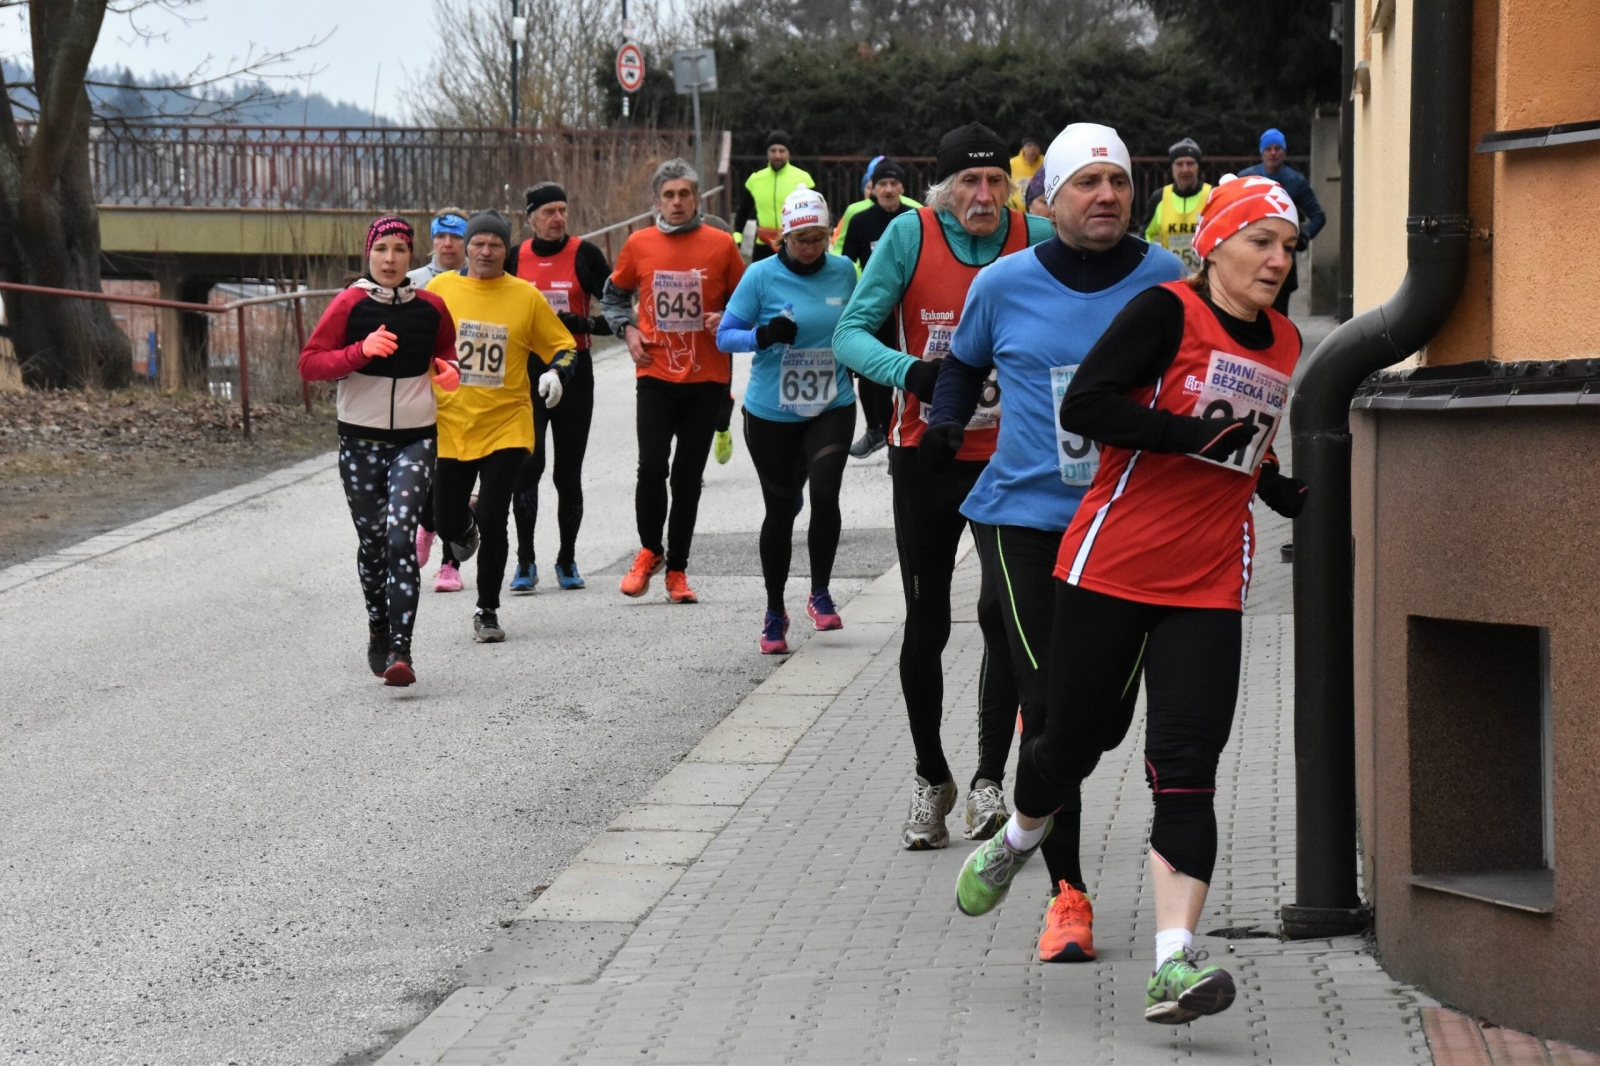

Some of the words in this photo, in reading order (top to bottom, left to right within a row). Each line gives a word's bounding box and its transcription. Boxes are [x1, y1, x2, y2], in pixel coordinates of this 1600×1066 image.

[656, 291, 702, 319] 643
[920, 308, 954, 321] Krakonoš
[929, 340, 950, 352] BĚŽ
[931, 330, 952, 341] ZIM
[458, 341, 504, 373] 219
[1215, 358, 1257, 381] ZIMNÍ
[782, 369, 834, 402] 637
[1211, 372, 1264, 401] BĚŽECKÁ
[1266, 391, 1284, 411] LIGA
